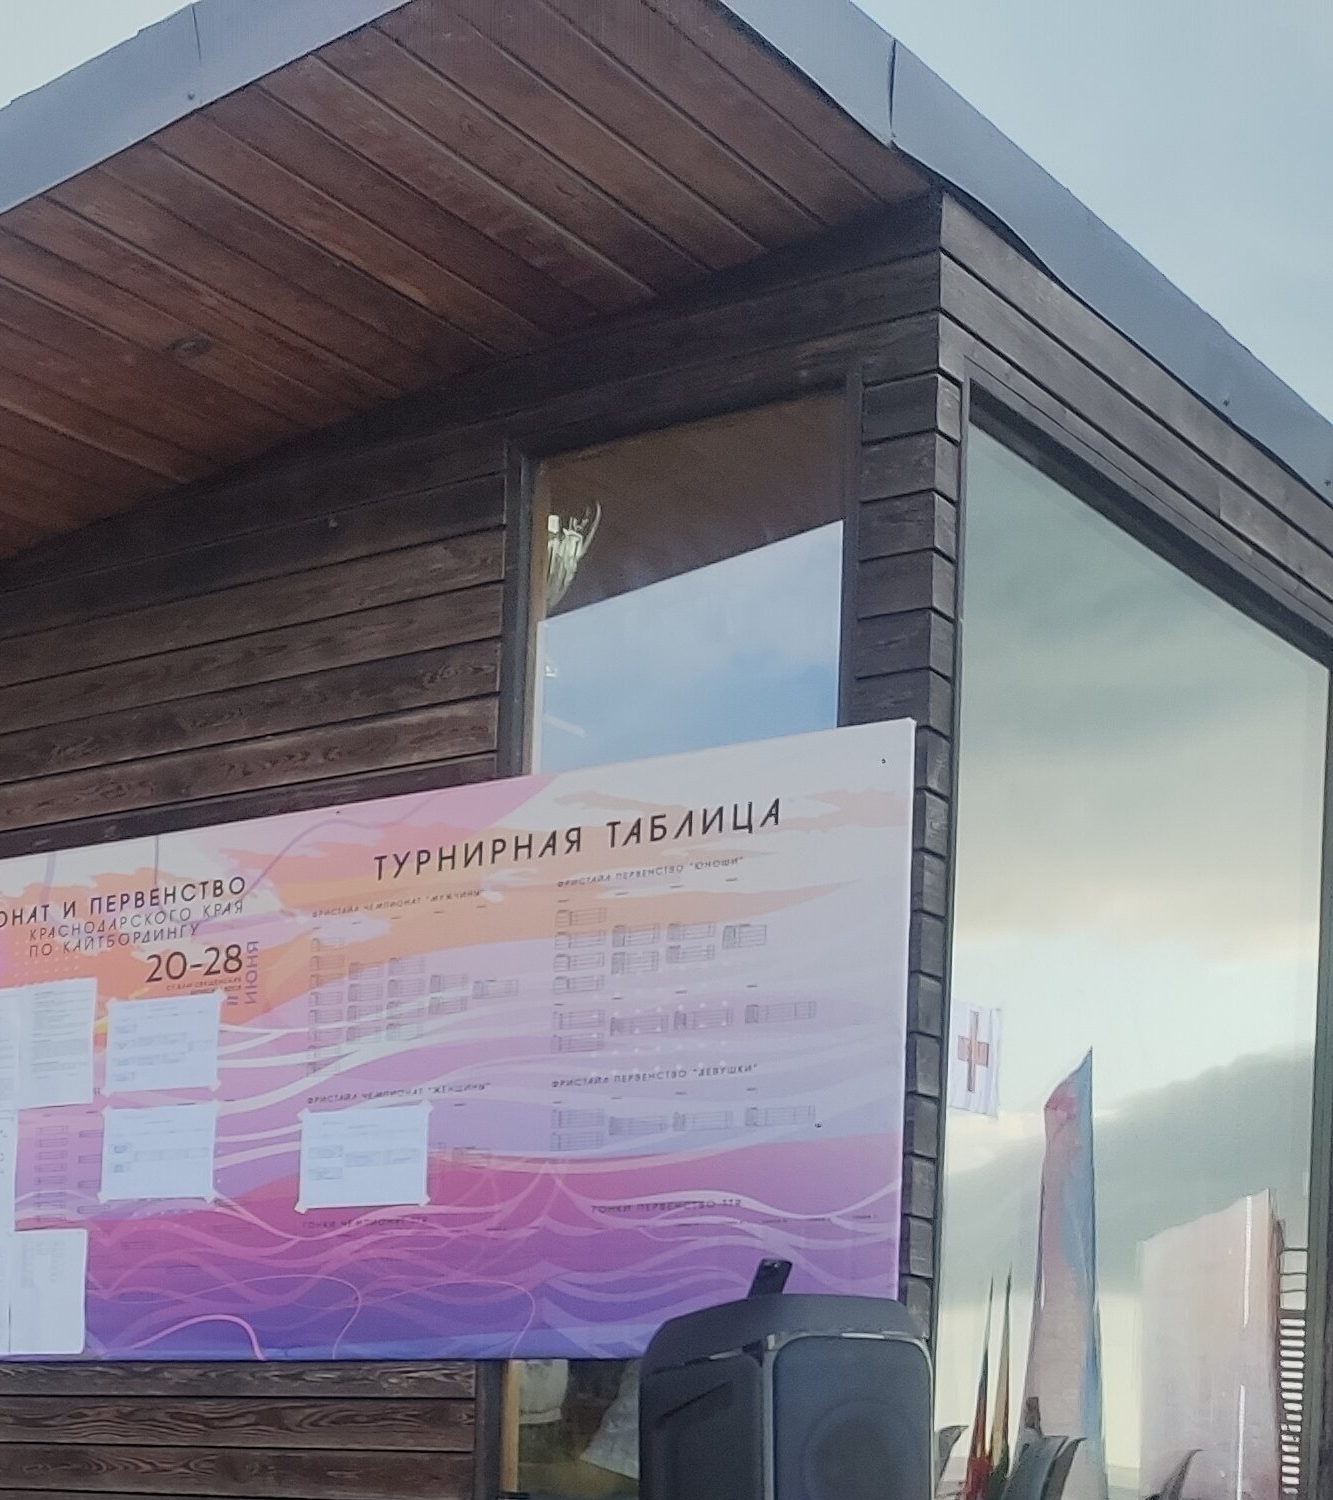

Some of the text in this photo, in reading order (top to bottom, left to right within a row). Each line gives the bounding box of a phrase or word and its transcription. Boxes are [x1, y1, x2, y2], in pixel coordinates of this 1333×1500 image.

[373, 797, 782, 881] ТУРНИРНАЯ ТАБЛИЦА
[63, 900, 77, 919] И
[90, 876, 247, 915] ПЕРВЕНСТВО
[29, 899, 244, 941] КРАСНОДАРСКОГО КРАЯ
[29, 922, 200, 958] ПО КАЙТБОРДИНГУ
[145, 944, 243, 983] 20-28
[245, 941, 260, 1005] ИЮНЯ
